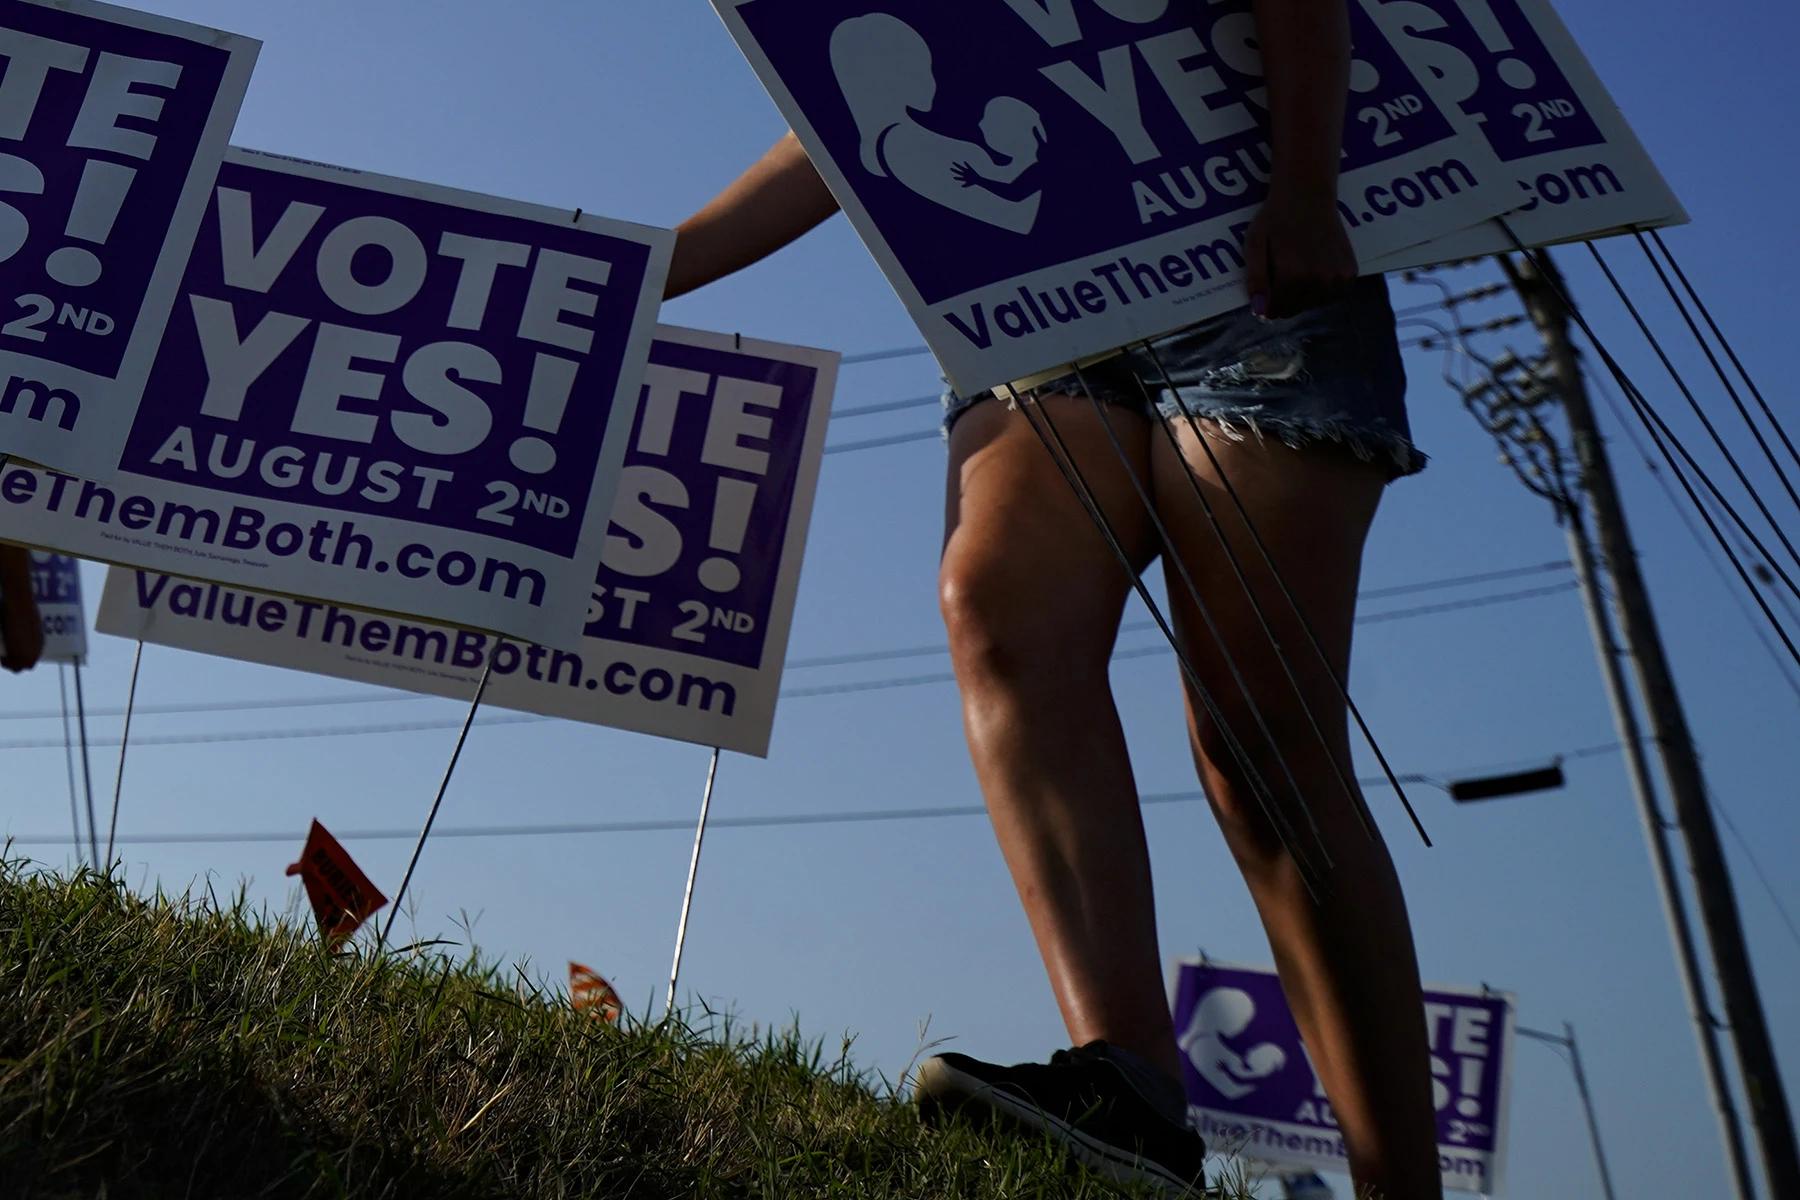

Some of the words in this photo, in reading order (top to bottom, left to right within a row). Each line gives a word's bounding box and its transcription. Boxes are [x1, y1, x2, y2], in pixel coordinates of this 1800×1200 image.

[1130, 141, 1272, 225] AUGU
[1356, 93, 1424, 148] 2ND
[1509, 97, 1577, 143] 2ND
[216, 185, 613, 355] VOTE
[943, 158, 1479, 351] ValueThem.com
[0, 292, 116, 343] 2ND
[188, 293, 581, 475] YES!
[635, 362, 784, 475] TE
[149, 424, 455, 512] AUGUST
[475, 480, 571, 527] 2ND
[600, 464, 759, 593] S!
[135, 569, 737, 717] ValueThemBoth.com
[670, 599, 756, 645] 2ND
[1423, 1001, 1493, 1058] TE
